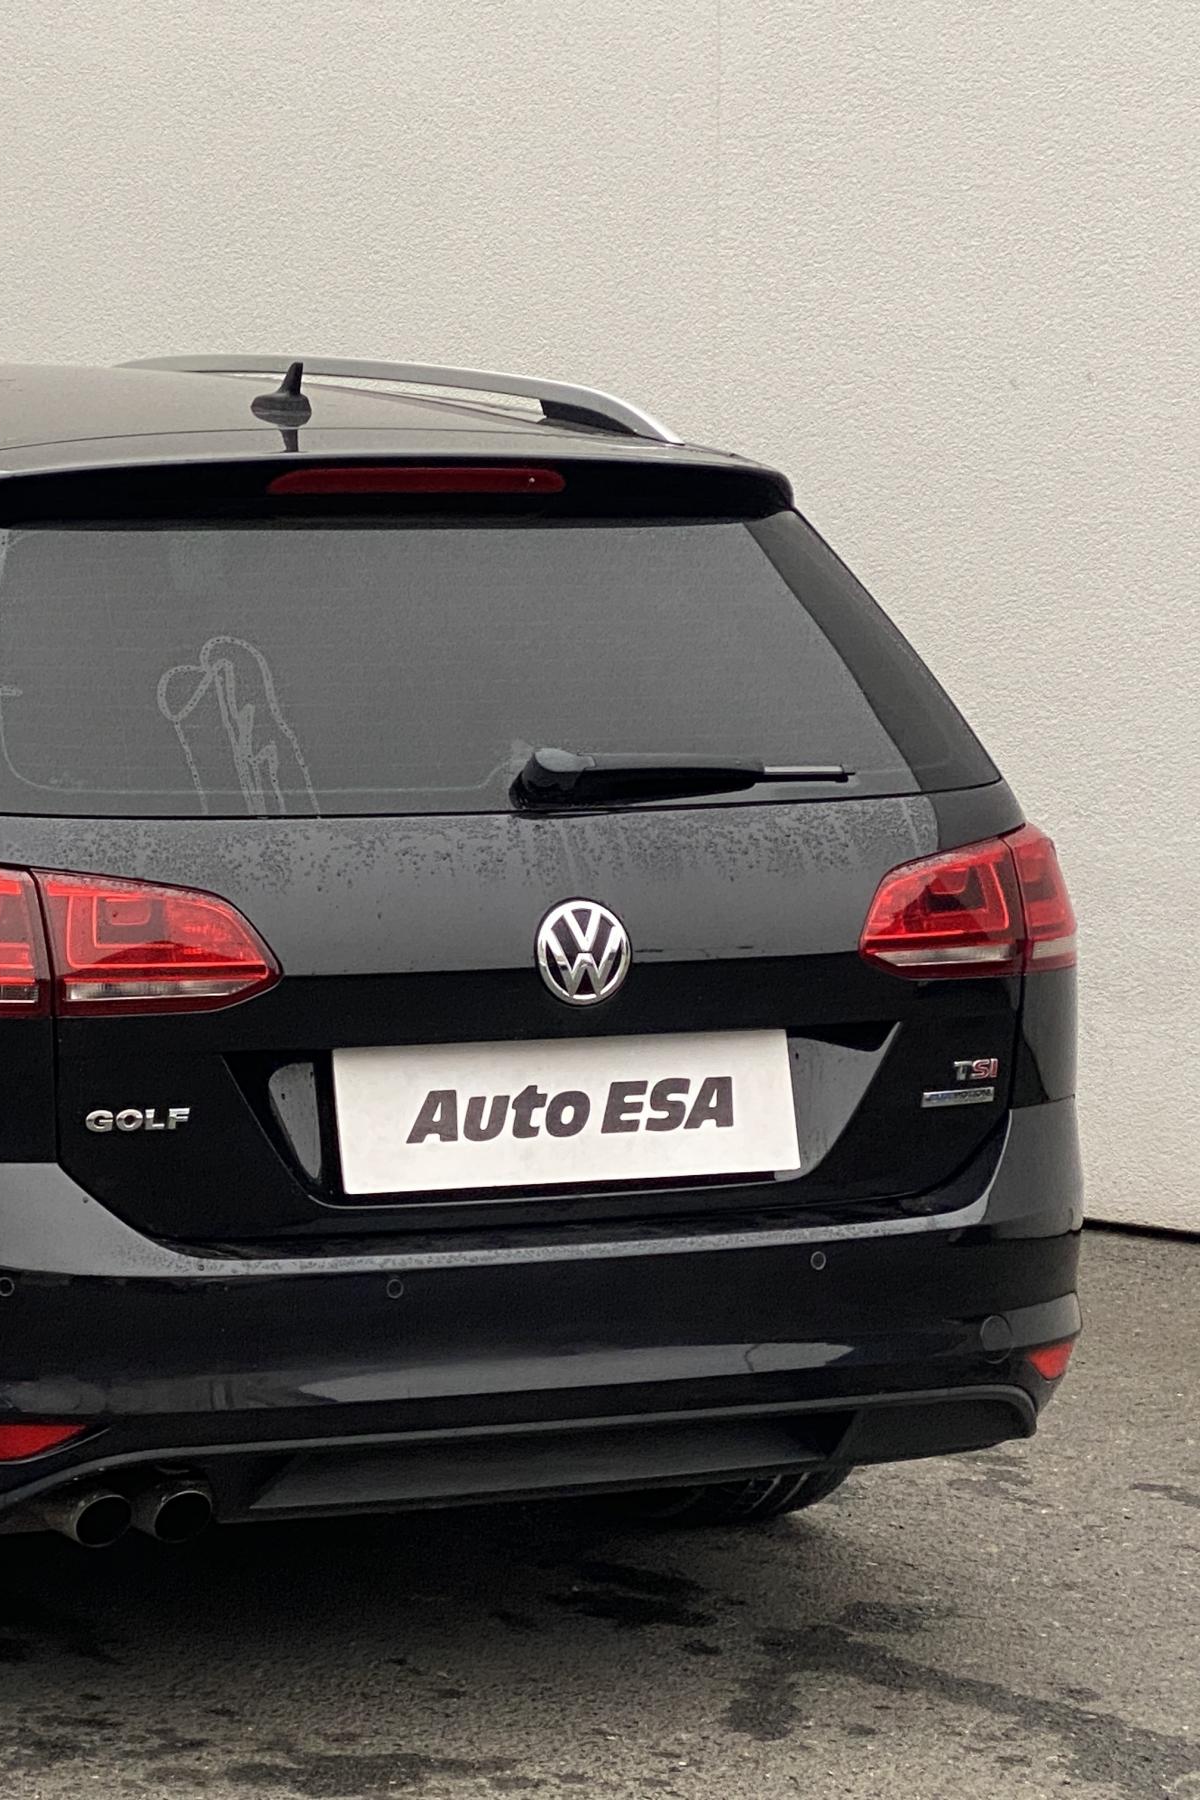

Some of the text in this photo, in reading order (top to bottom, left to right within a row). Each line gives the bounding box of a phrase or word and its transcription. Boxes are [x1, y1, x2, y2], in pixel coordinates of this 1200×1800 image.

[953, 1058, 998, 1080] TSI
[85, 1107, 190, 1132] GOLF
[406, 1077, 733, 1143] Auto ESA
